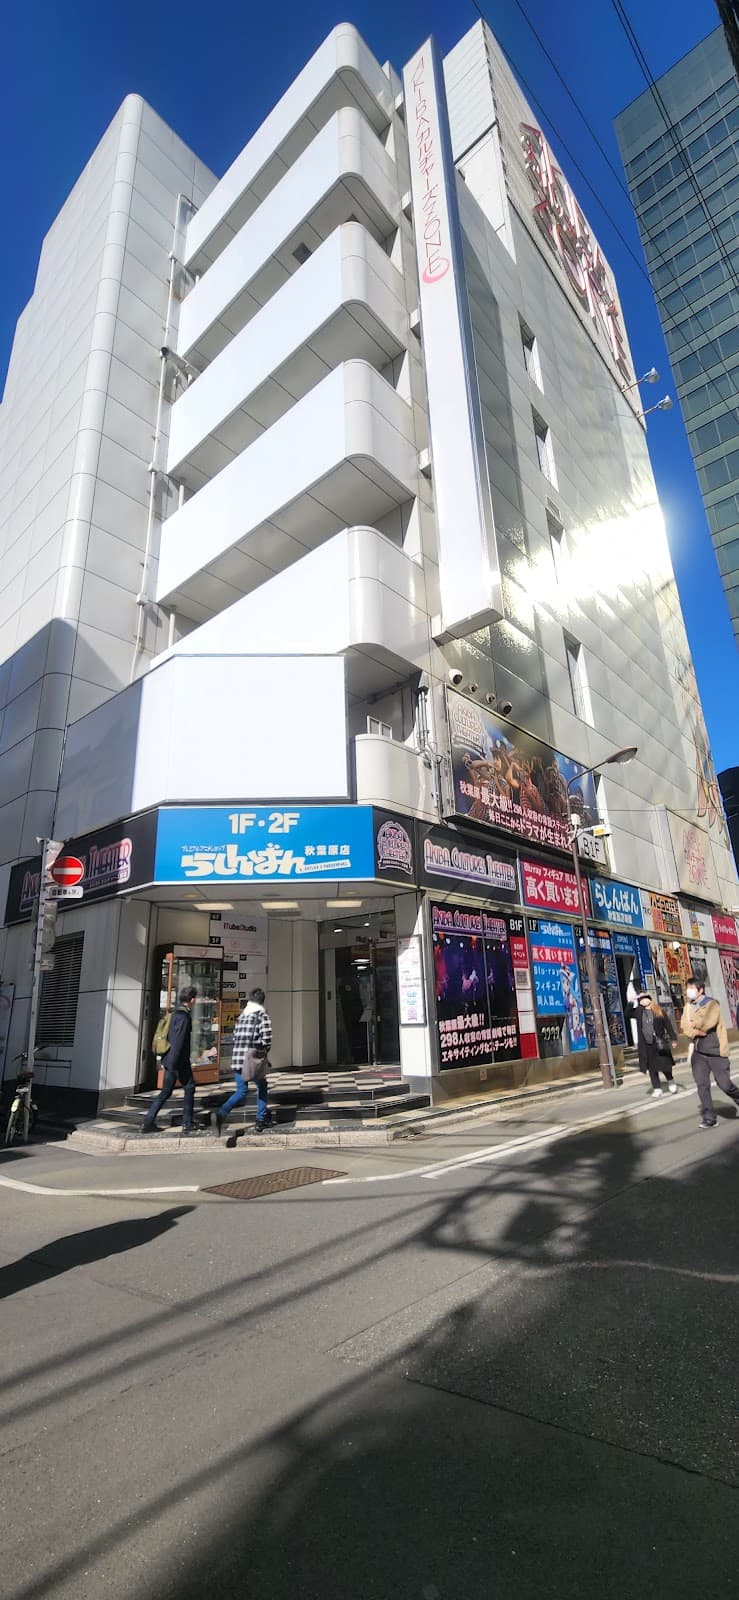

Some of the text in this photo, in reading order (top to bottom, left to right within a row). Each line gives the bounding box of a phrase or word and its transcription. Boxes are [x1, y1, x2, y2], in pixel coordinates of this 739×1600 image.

[304, 844, 351, 857] 秋葉原店
[583, 837, 601, 859] B1F
[180, 842, 306, 877] らしんばん
[424, 839, 515, 881] AKIBA CULTURES THEATER
[543, 867, 563, 882] フィギュア
[594, 883, 639, 915] らしんばん
[432, 906, 453, 926] AKIBA
[509, 918, 523, 931] B1F
[535, 981, 561, 992] フィギュア
